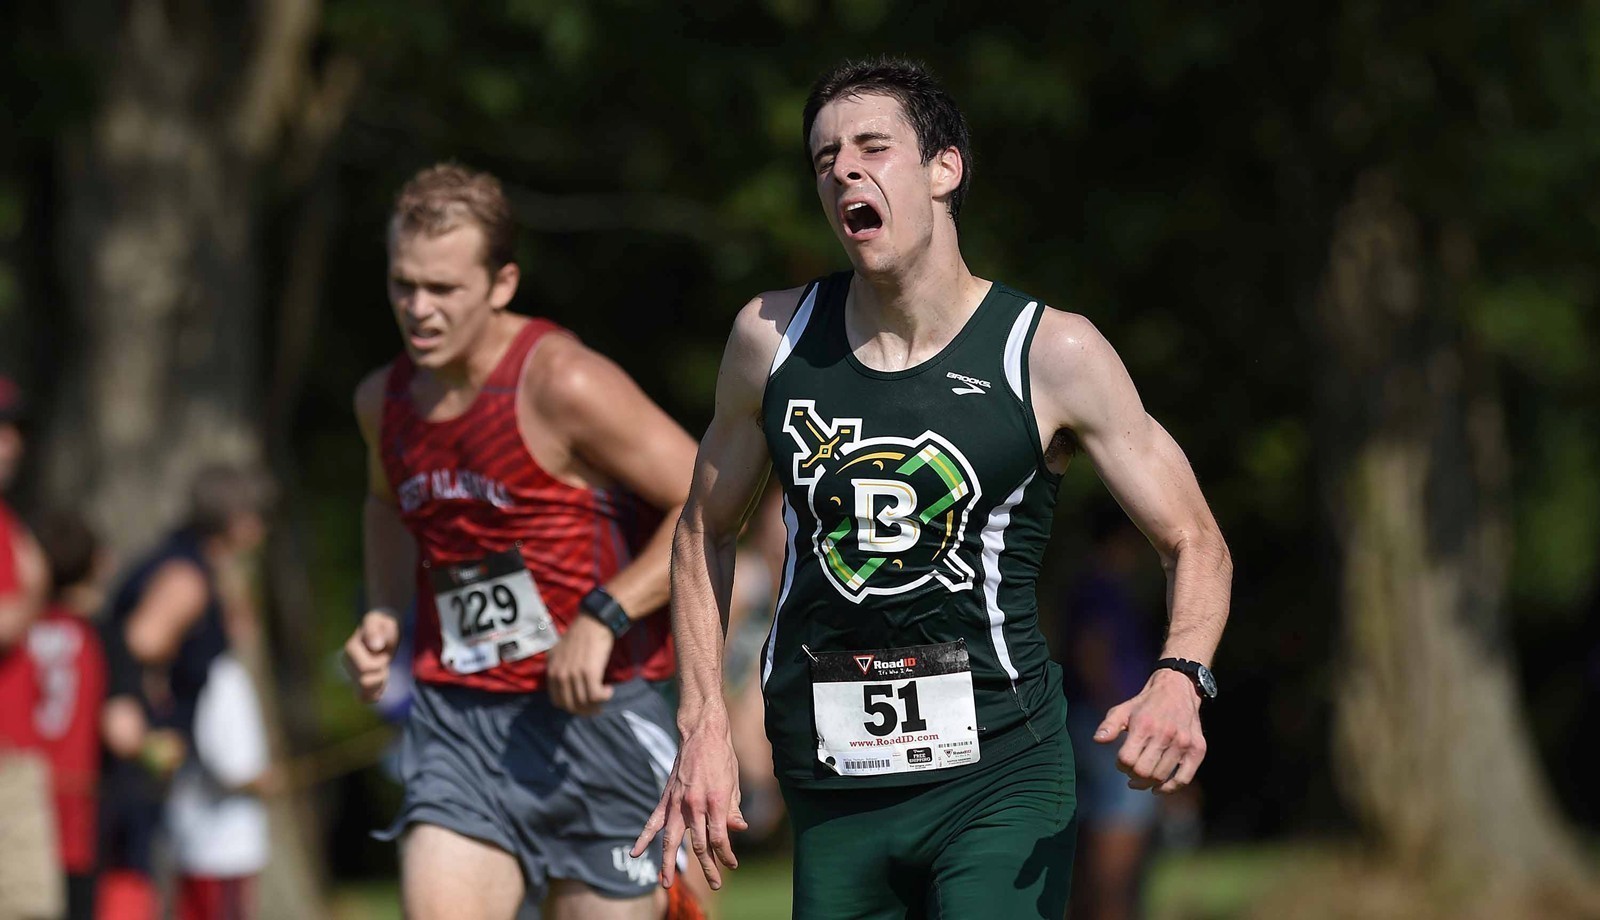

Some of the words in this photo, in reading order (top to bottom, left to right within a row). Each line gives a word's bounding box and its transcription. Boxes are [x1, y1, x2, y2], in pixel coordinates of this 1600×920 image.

[946, 371, 992, 388] BROOKS
[397, 471, 429, 512] EST
[851, 478, 921, 552] B
[451, 584, 518, 638] 229
[873, 657, 917, 670] RoadID
[863, 680, 927, 737] 51
[849, 733, 940, 748] www.RoadID.com
